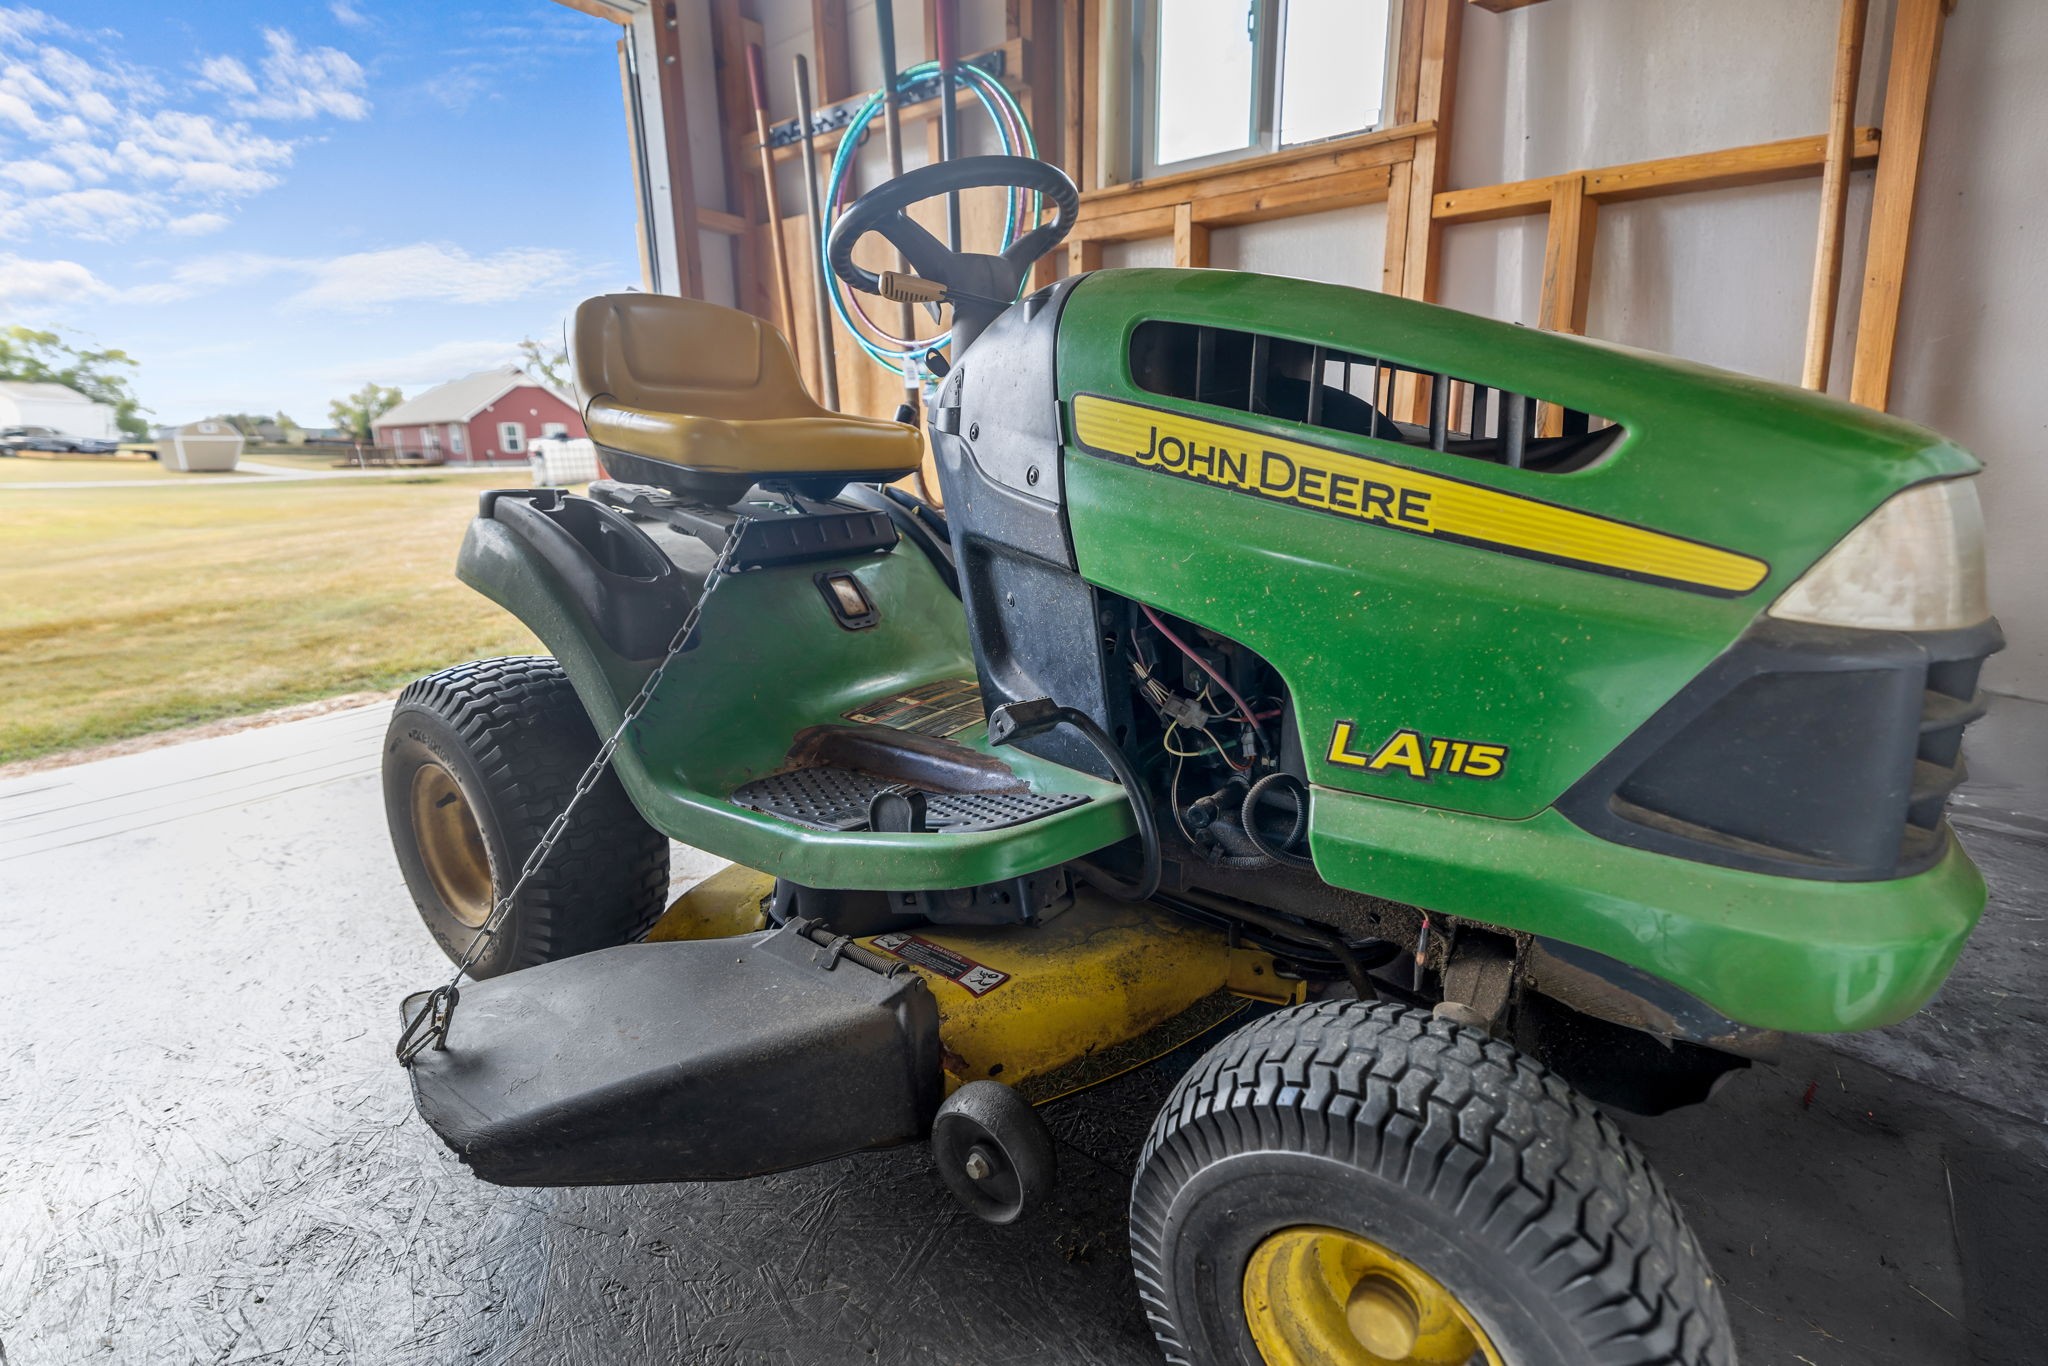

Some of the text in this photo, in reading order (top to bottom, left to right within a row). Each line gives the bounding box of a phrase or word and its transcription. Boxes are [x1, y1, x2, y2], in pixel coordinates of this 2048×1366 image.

[1135, 426, 1432, 526] JOHN DEERE
[1327, 721, 1507, 779] LA115
[933, 945, 963, 961] DANGER
